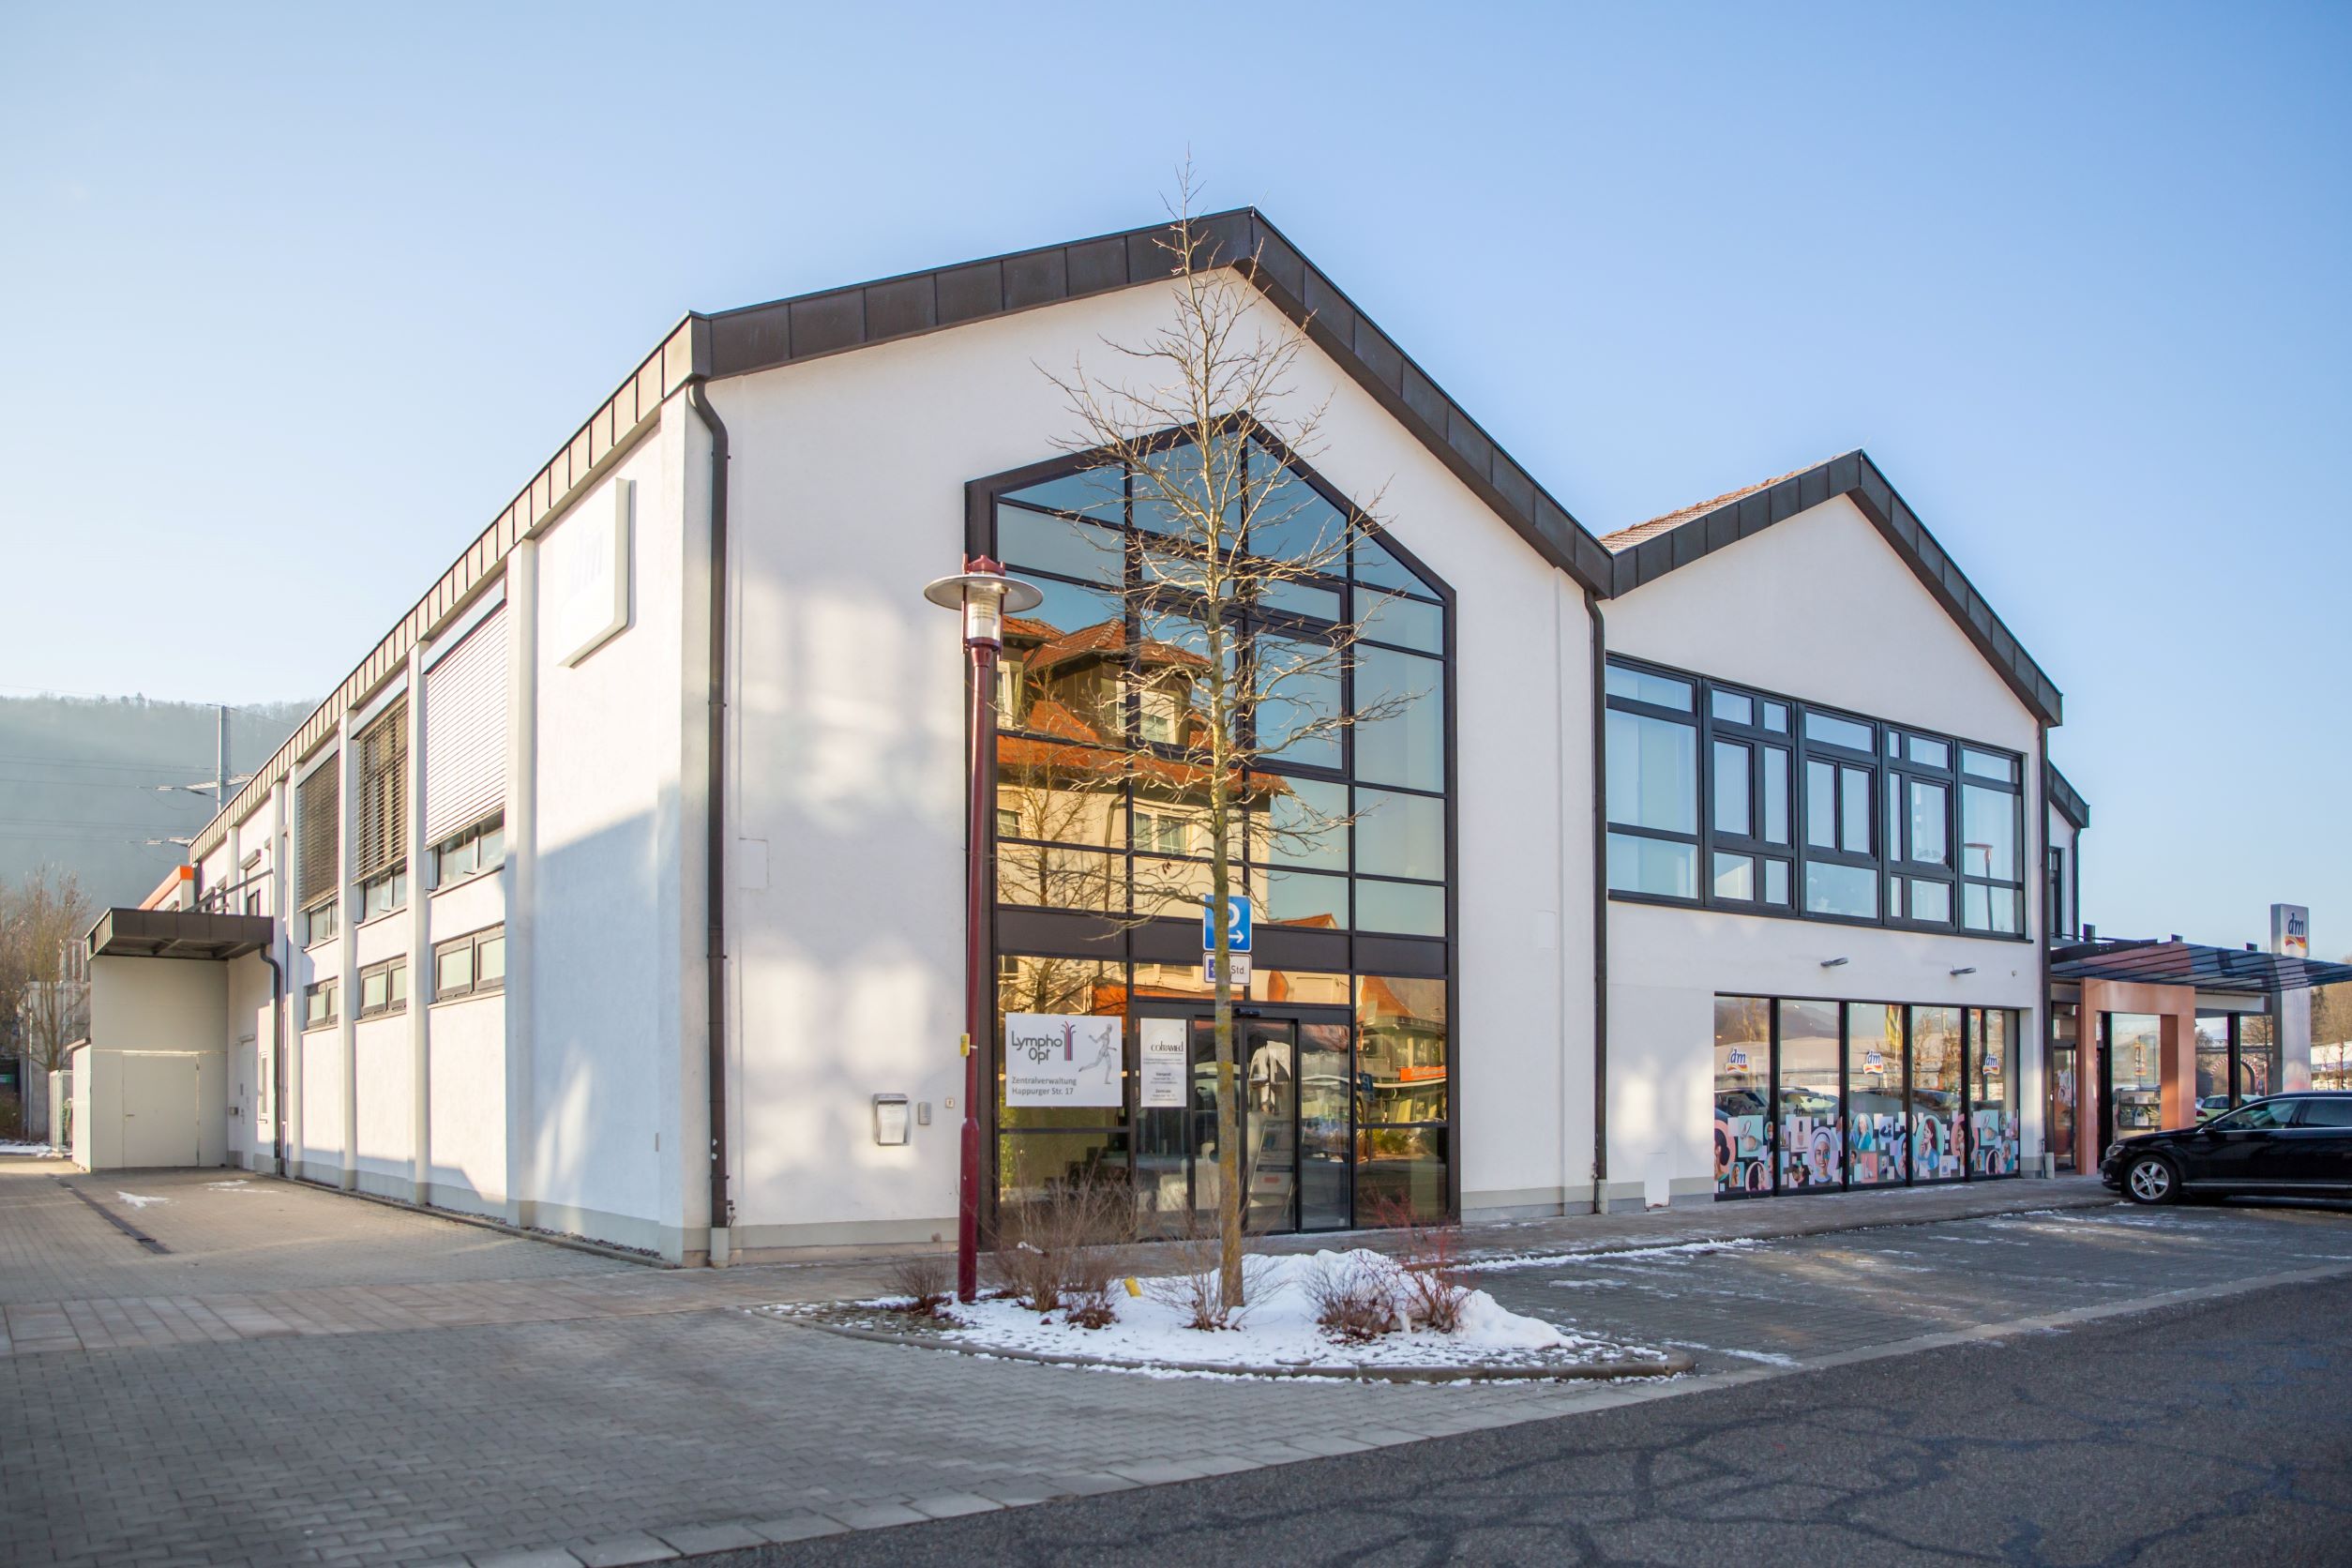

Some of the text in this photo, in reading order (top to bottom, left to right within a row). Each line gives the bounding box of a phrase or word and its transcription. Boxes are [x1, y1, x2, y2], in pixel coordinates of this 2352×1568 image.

[2288, 912, 2304, 936] dm
[1011, 1030, 1063, 1051] Lympho
[1028, 1047, 1050, 1065] Opt
[1730, 1048, 1746, 1063] dm
[1867, 1050, 1880, 1064] dm
[1985, 1053, 1998, 1065] dm
[1012, 1077, 1078, 1086] Zentralverwaltung
[1012, 1087, 1050, 1096] Happurger
